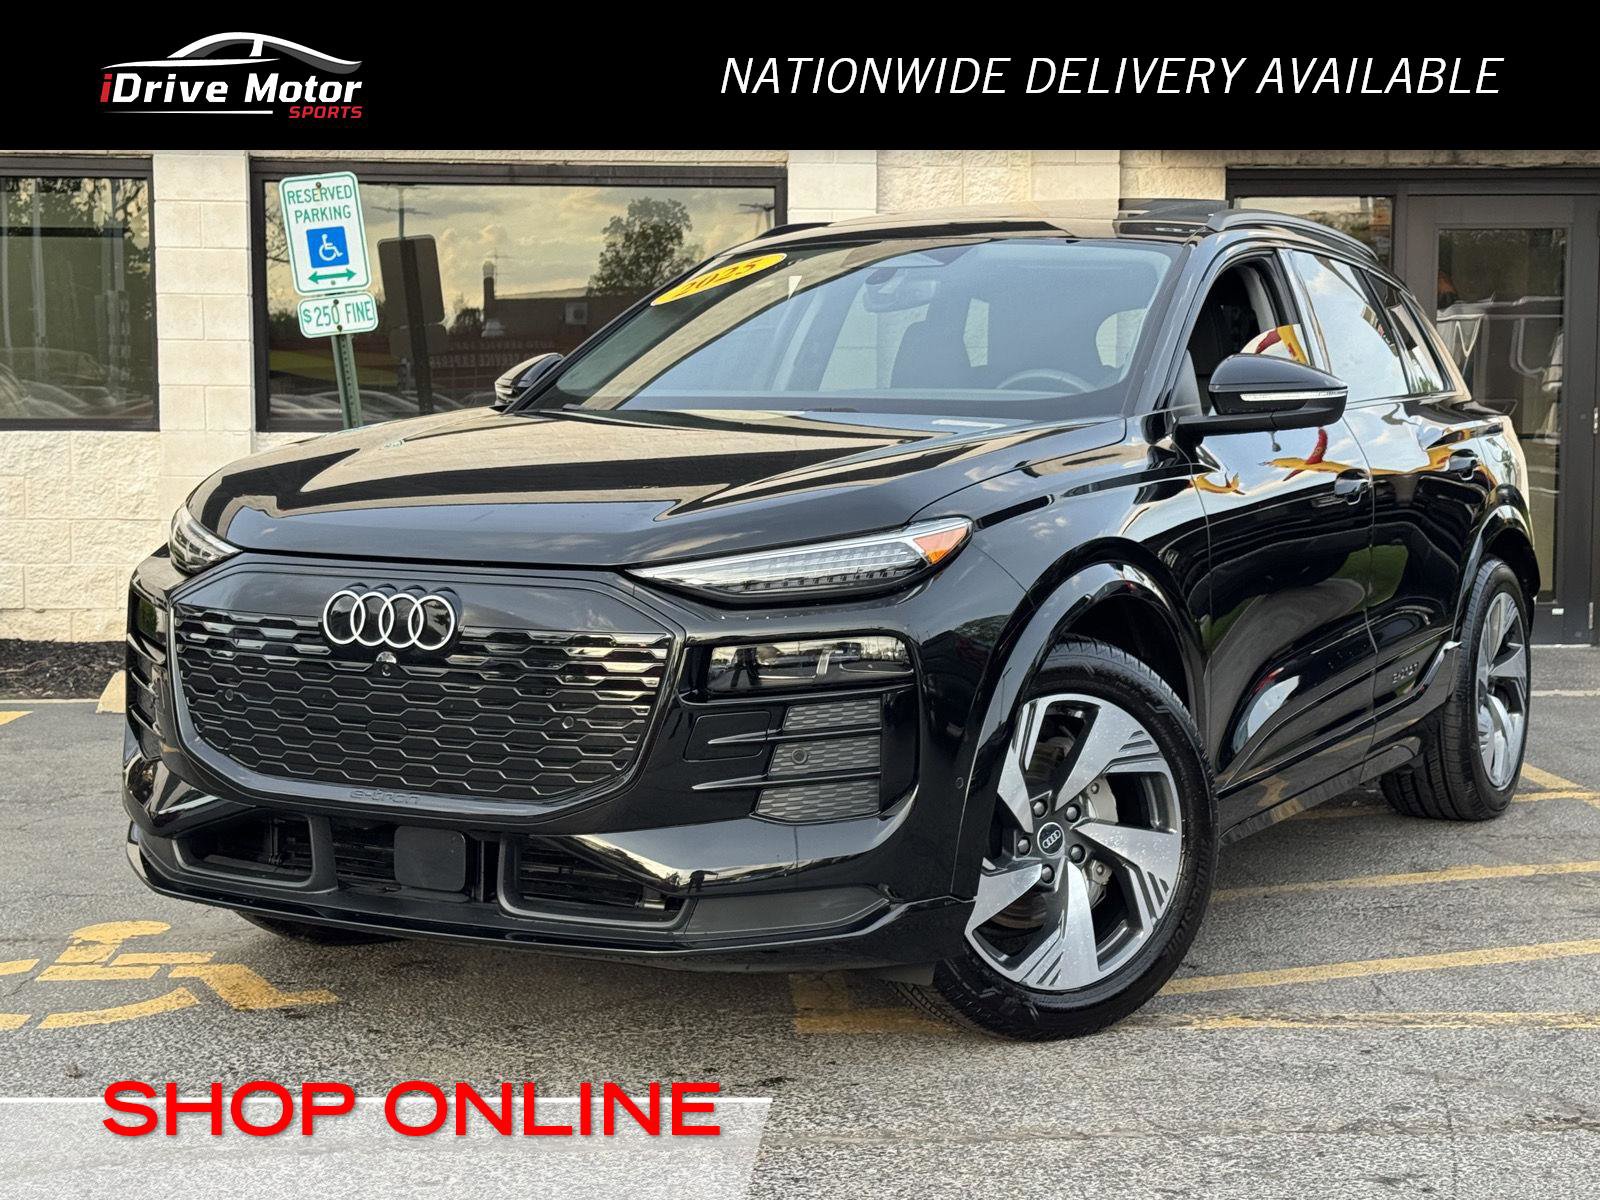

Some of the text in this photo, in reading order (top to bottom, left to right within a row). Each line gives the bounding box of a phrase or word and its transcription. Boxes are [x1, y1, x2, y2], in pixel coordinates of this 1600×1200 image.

[287, 184, 353, 205] RESERVED
[294, 205, 352, 224] PARKING
[671, 258, 764, 299] 2025
[345, 301, 374, 324] FINE
